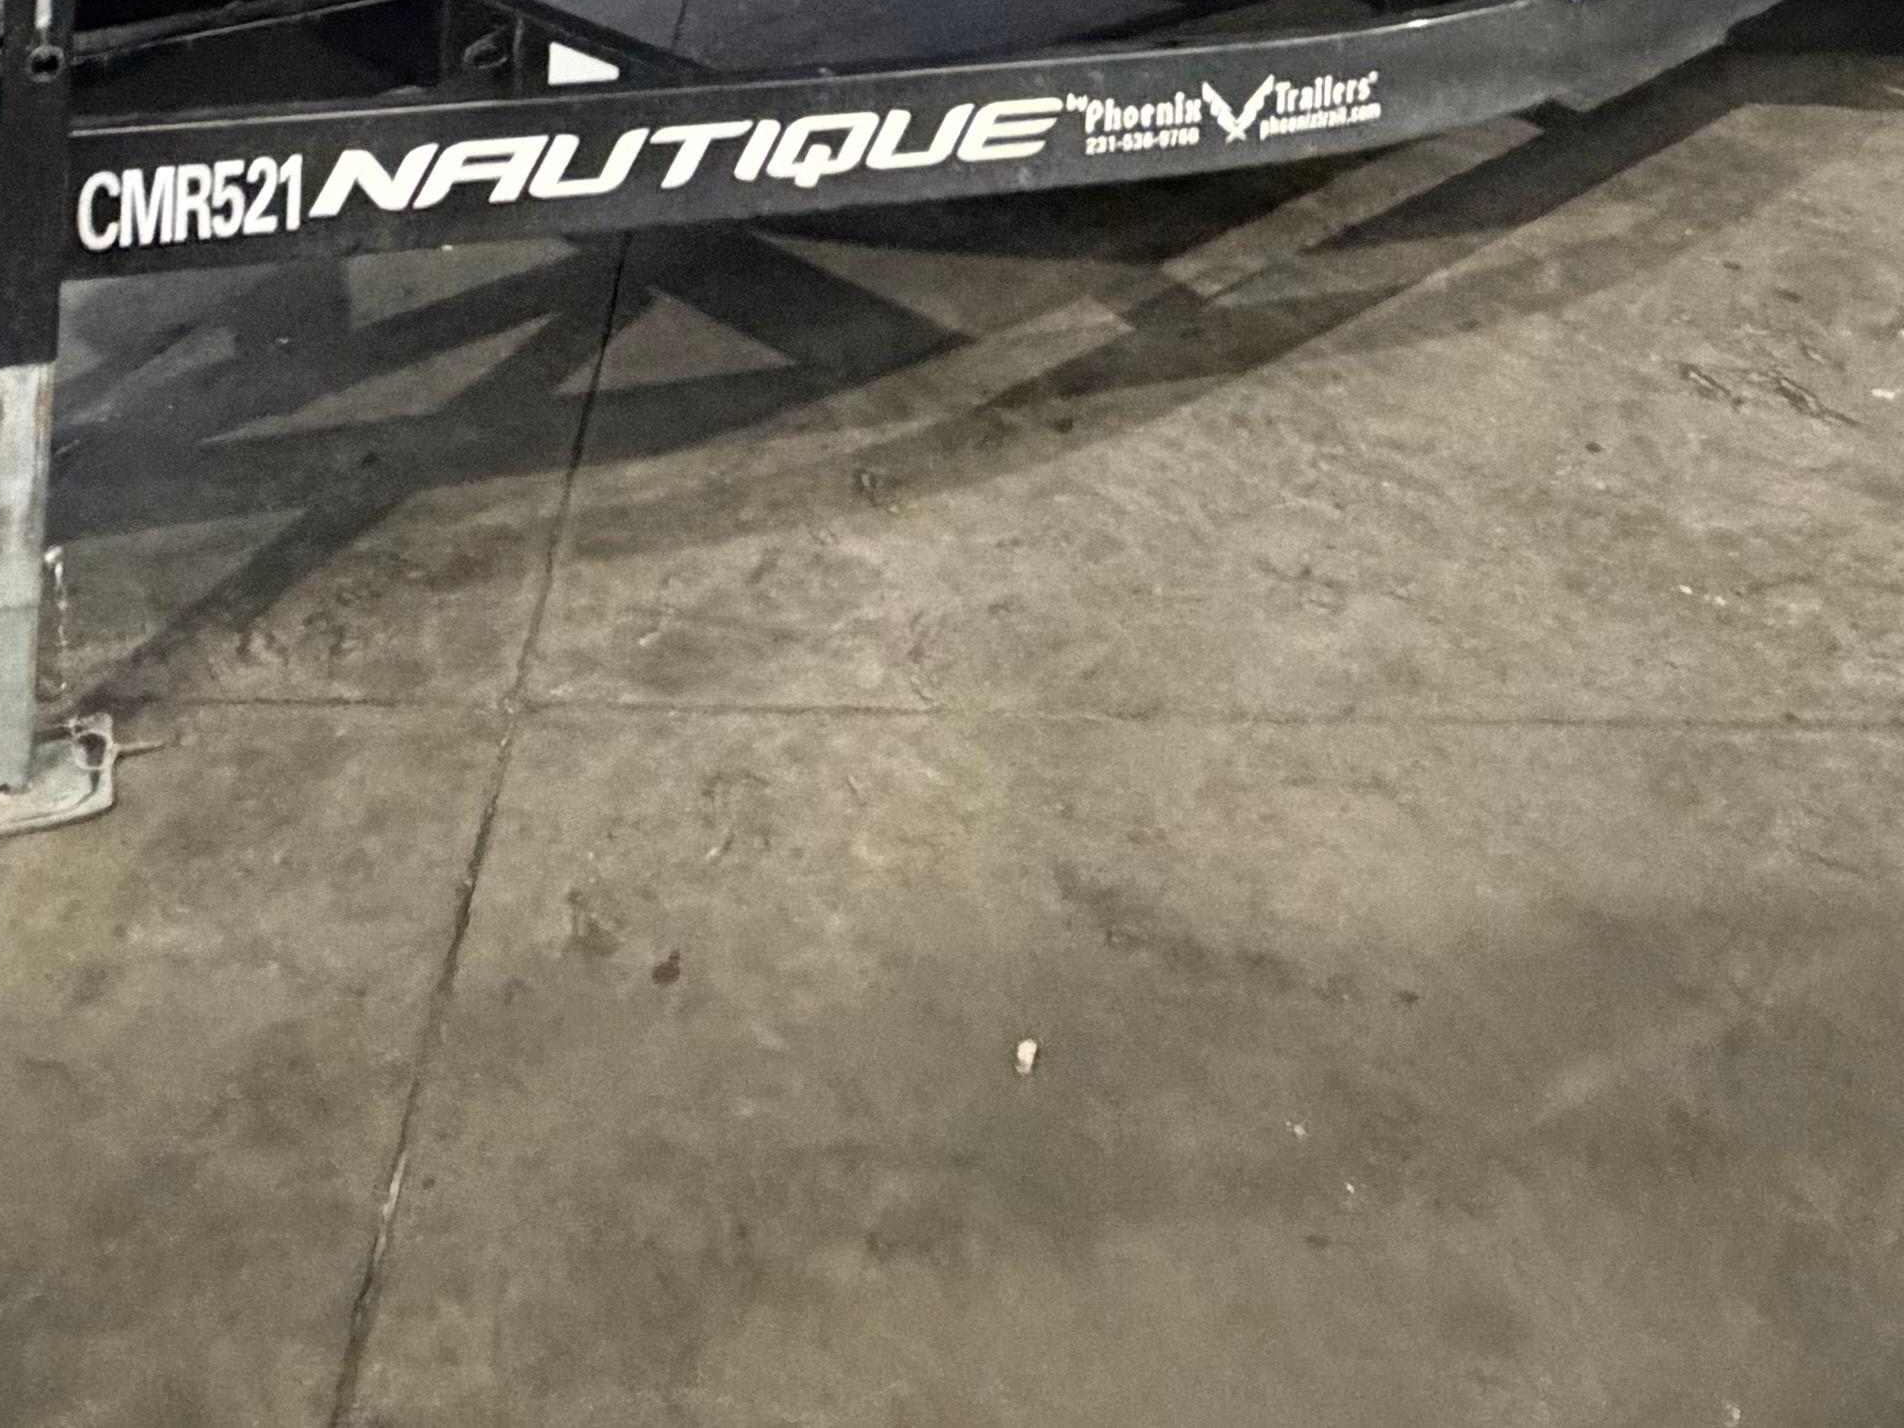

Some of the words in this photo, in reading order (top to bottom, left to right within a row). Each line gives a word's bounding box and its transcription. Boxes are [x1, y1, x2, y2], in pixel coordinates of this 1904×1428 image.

[308, 97, 1064, 217] NAUTIQUE
[1085, 91, 1202, 134] Phoenix
[77, 153, 303, 251] CMR521
